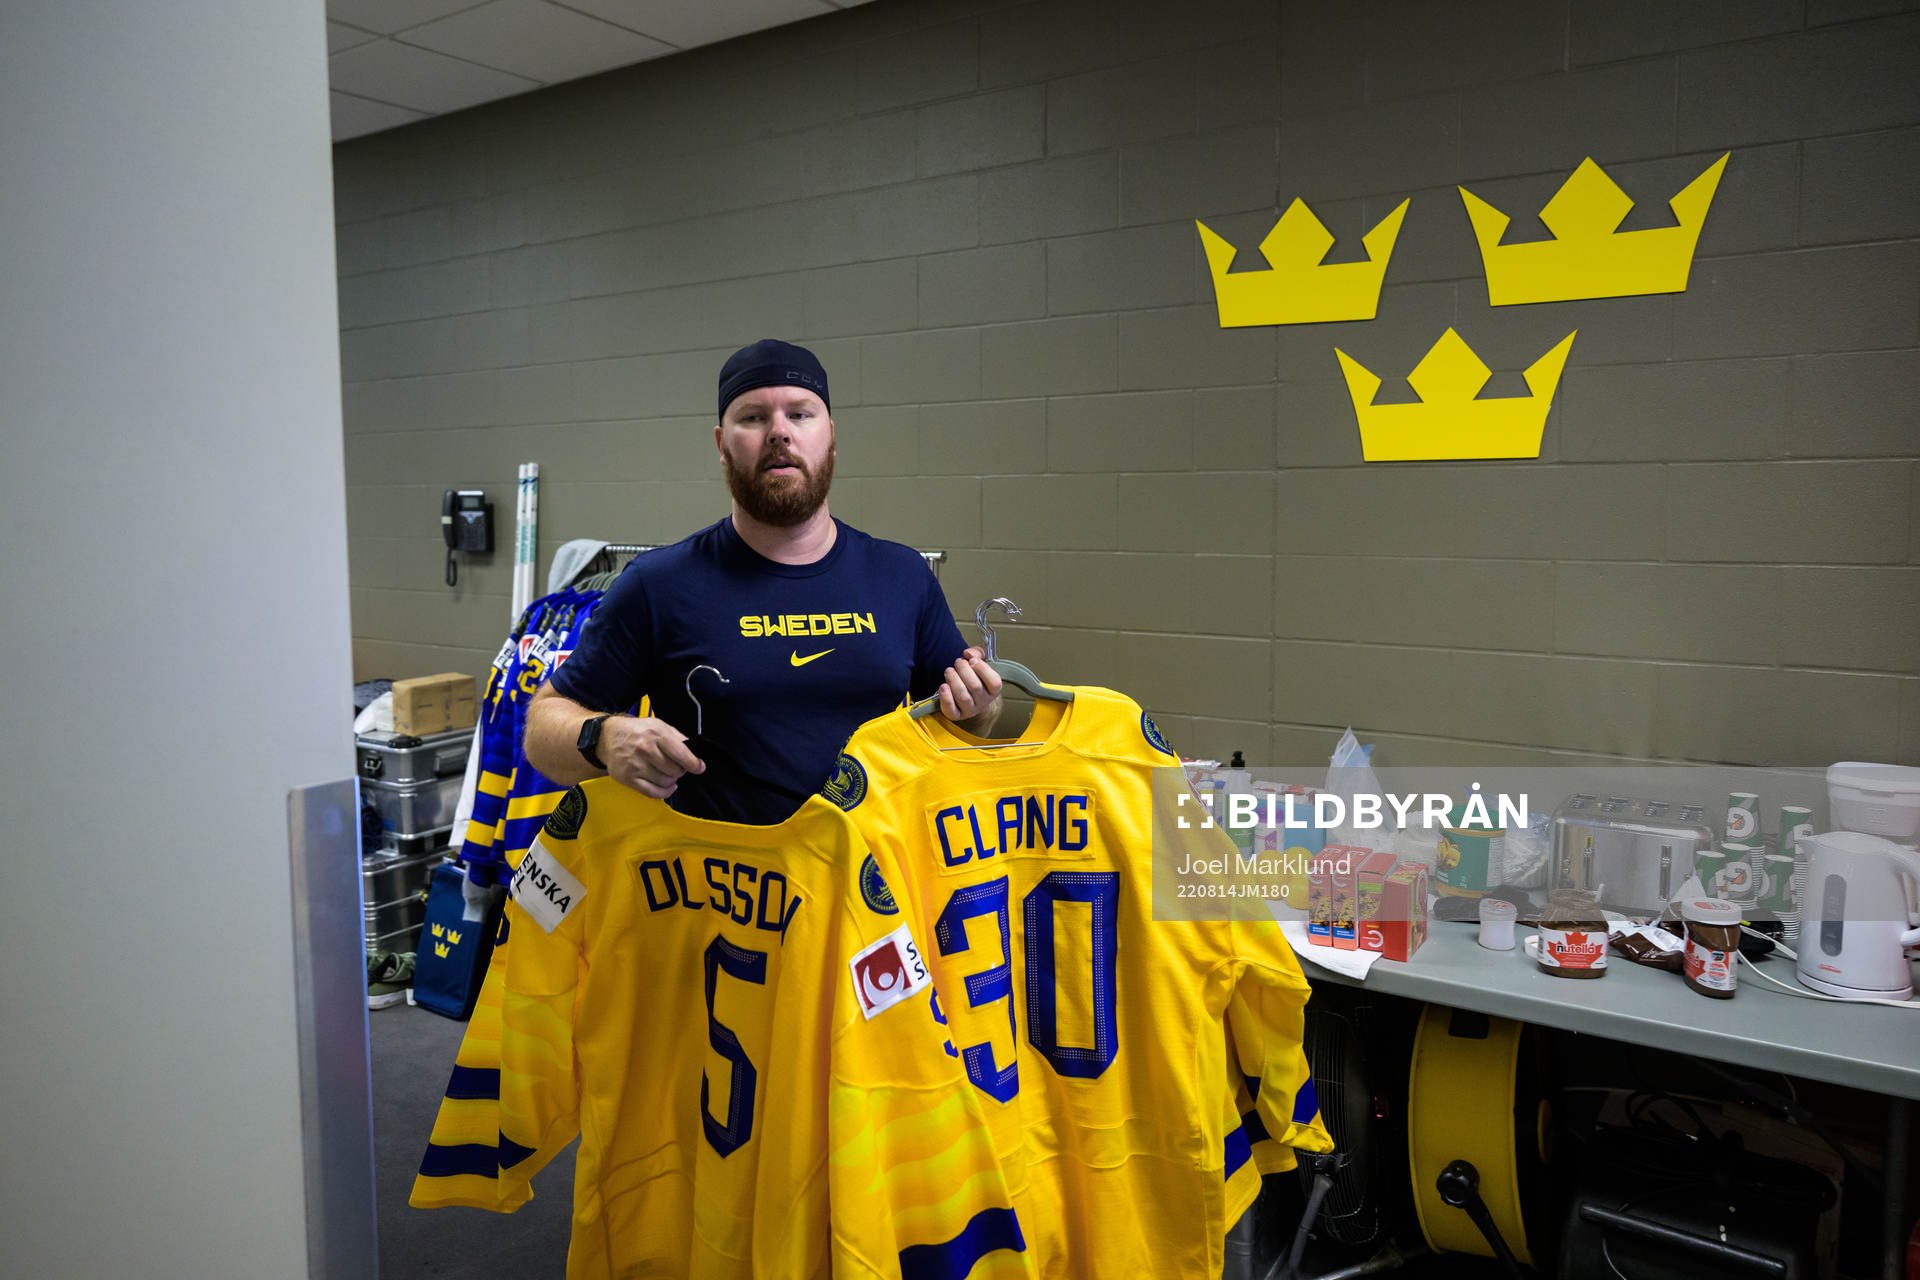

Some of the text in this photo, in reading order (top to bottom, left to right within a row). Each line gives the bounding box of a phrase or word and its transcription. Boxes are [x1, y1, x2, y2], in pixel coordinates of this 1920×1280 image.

[739, 611, 877, 638] SWEDEN
[935, 794, 1090, 867] CLANG
[1556, 943, 1596, 955] nutella
[934, 871, 1121, 1104] 30
[700, 932, 768, 1159] 5
